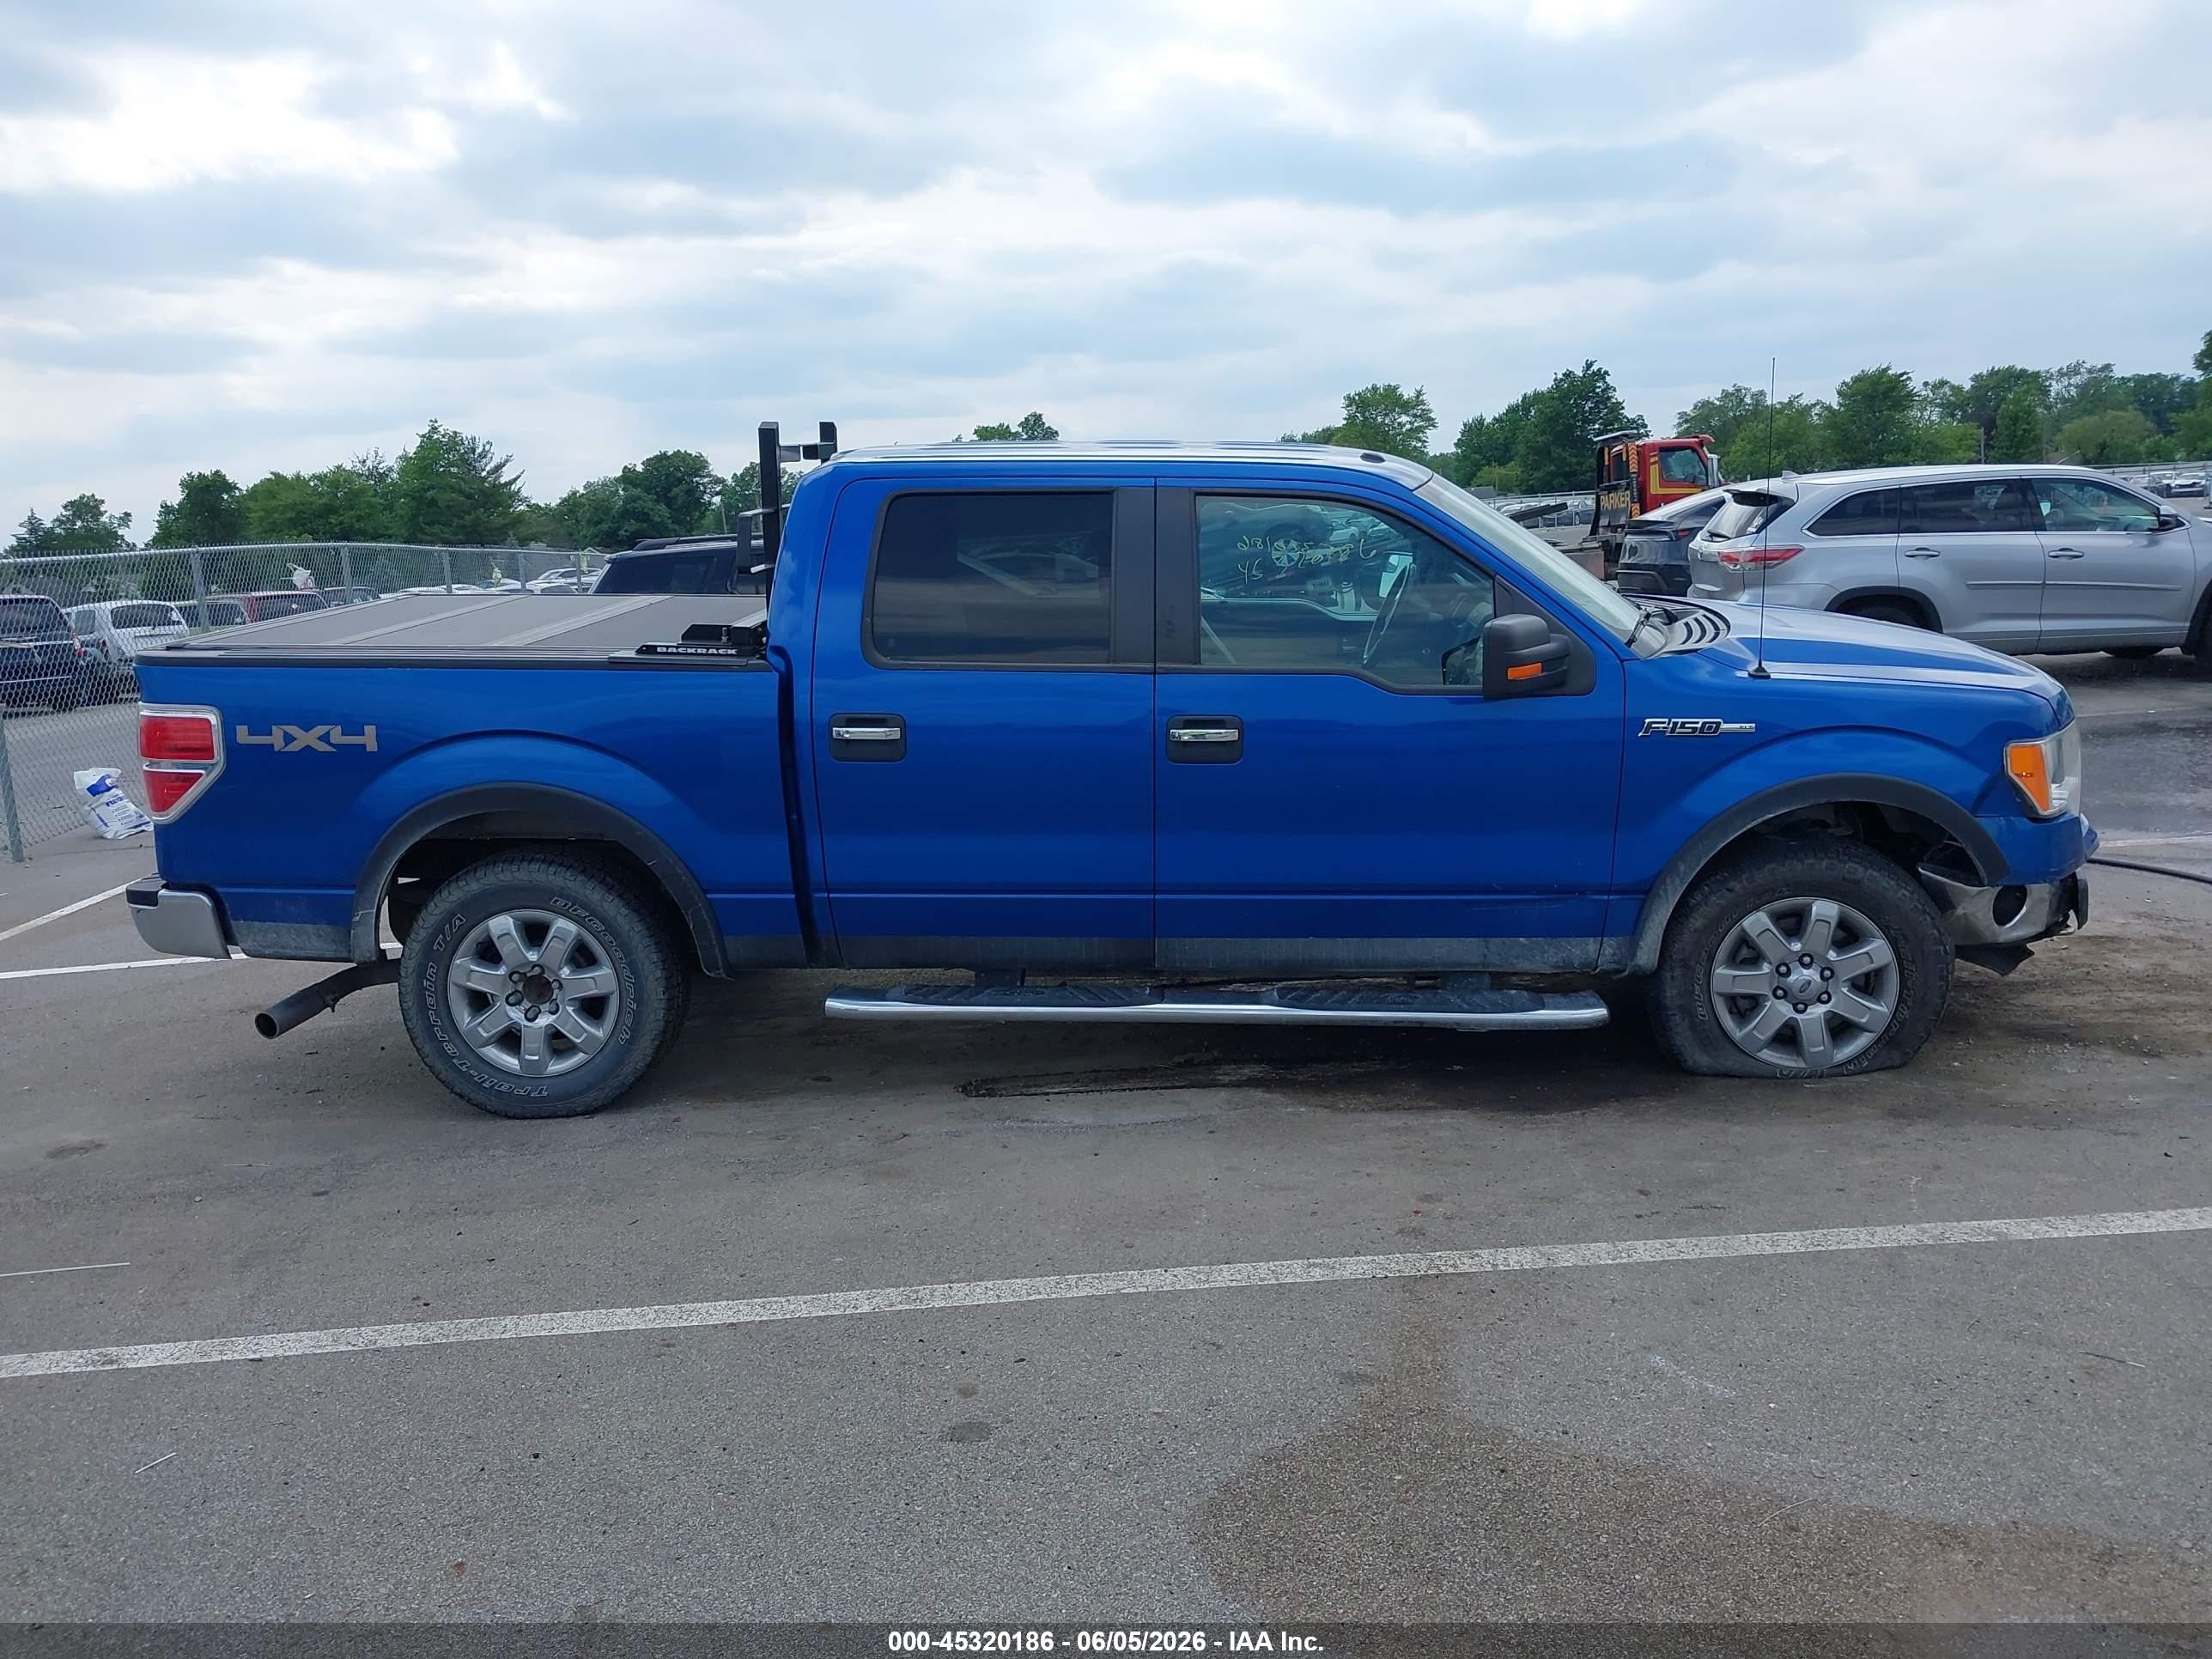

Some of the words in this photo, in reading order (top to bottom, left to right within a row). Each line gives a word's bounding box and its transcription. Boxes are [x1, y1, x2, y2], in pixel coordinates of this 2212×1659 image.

[1600, 490, 1630, 510] PARKER
[656, 646, 738, 655] BACKRACK
[235, 725, 379, 752] 4X4
[433, 913, 467, 953] T/A
[550, 896, 638, 1045] BFGoodrich
[424, 961, 550, 1097] Trail-Terrain
